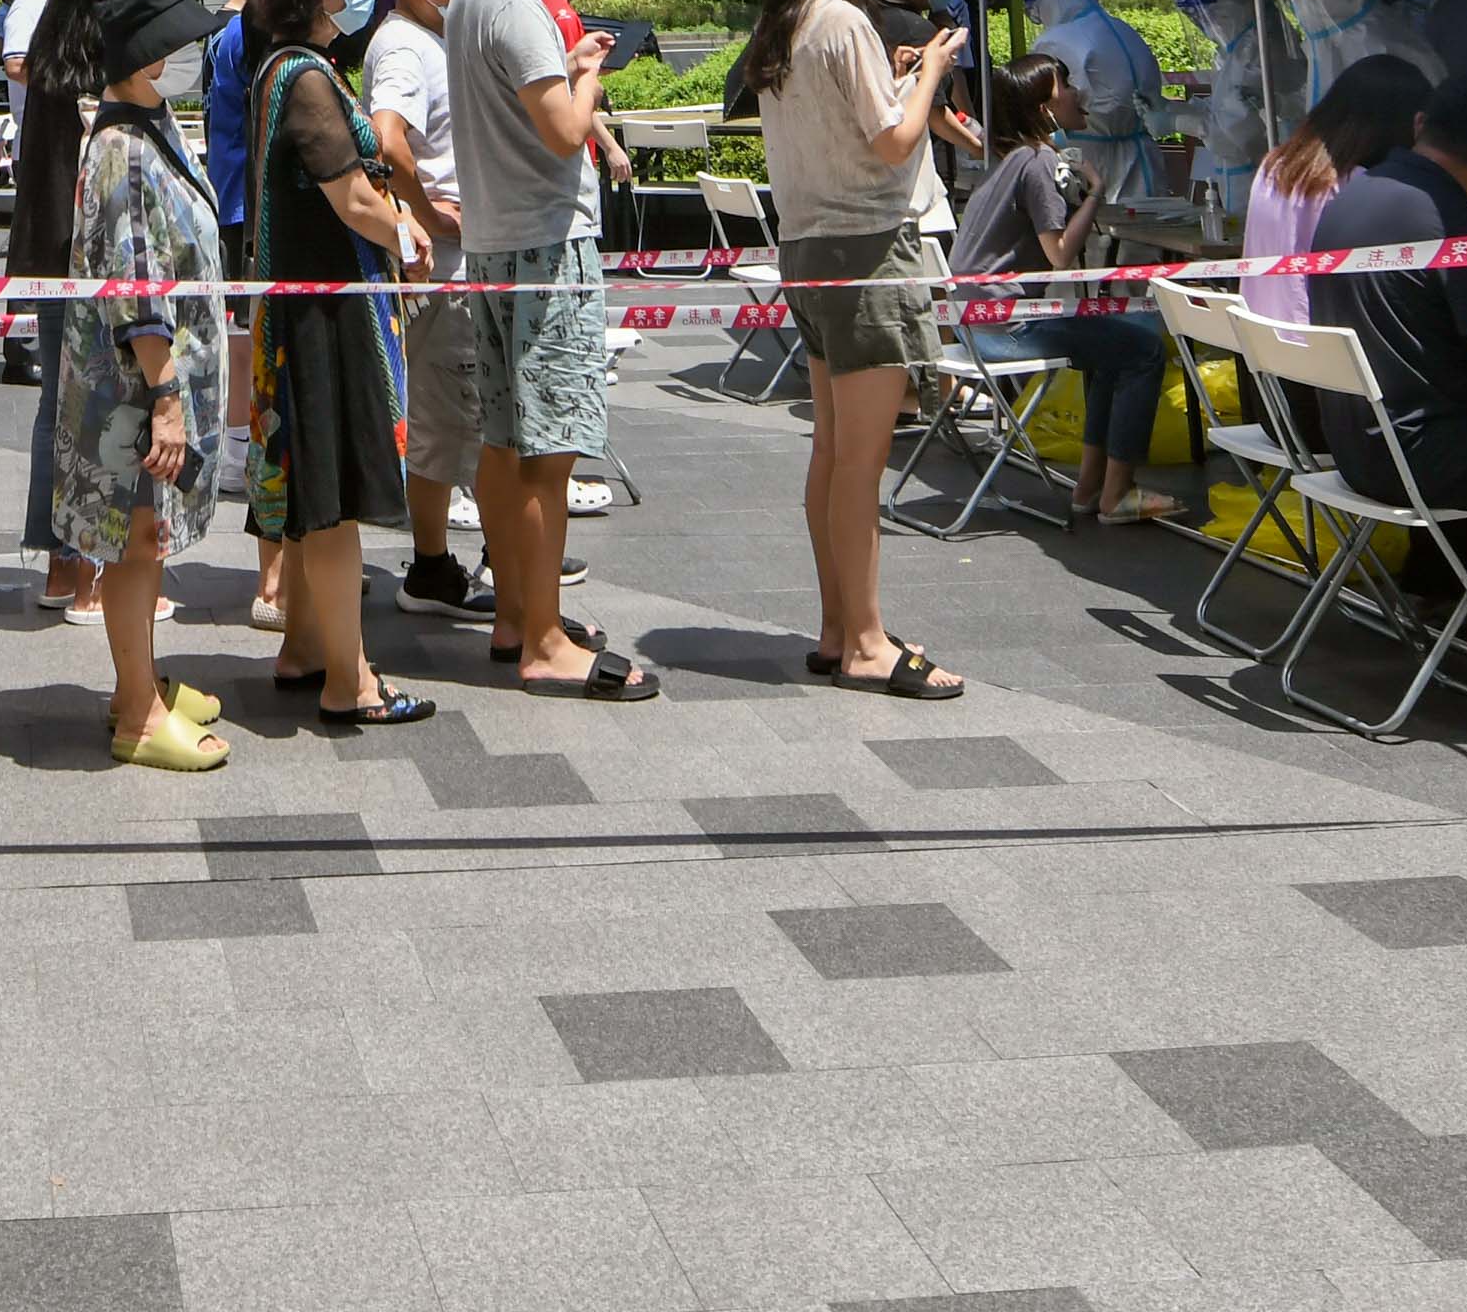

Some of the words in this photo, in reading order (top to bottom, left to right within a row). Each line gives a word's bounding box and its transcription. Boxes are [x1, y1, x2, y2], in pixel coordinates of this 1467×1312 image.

[1368, 245, 1416, 262] 注意
[1288, 253, 1336, 268] 安全
[1355, 256, 1415, 270] CAUTION
[30, 280, 78, 292] 注意
[974, 302, 1007, 316] 安全
[1029, 300, 1064, 313] 注意
[1088, 298, 1120, 312] 安全
[633, 309, 667, 321] 安全
[689, 308, 723, 320] 注意
[747, 307, 779, 320] 安全
[969, 313, 1004, 322] SAFE
[628, 319, 663, 327] SAFE
[682, 317, 723, 326] CAUTION
[741, 316, 776, 325] SAFE
